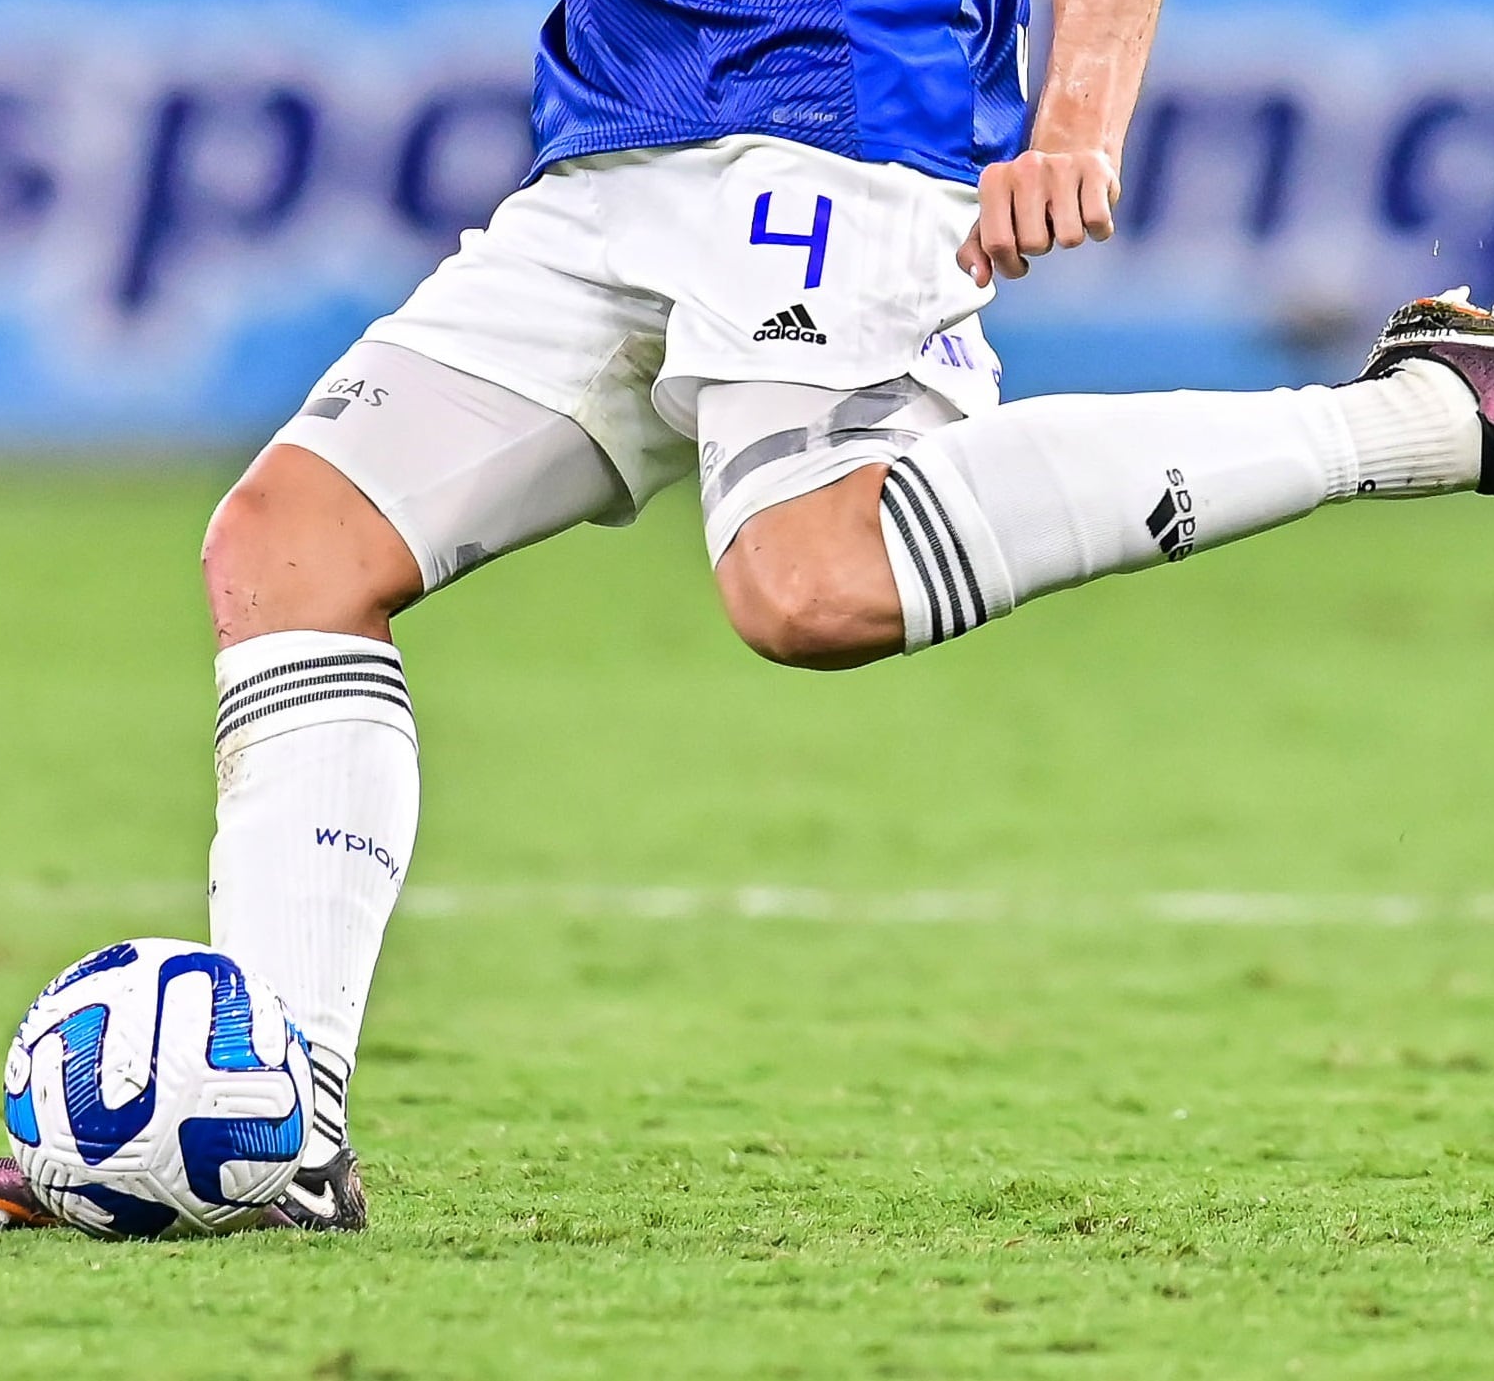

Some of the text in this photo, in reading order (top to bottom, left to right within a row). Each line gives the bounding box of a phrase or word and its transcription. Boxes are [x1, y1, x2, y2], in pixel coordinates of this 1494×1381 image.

[749, 191, 833, 290] 4
[752, 324, 827, 346] adidas
[327, 378, 390, 407] GAS
